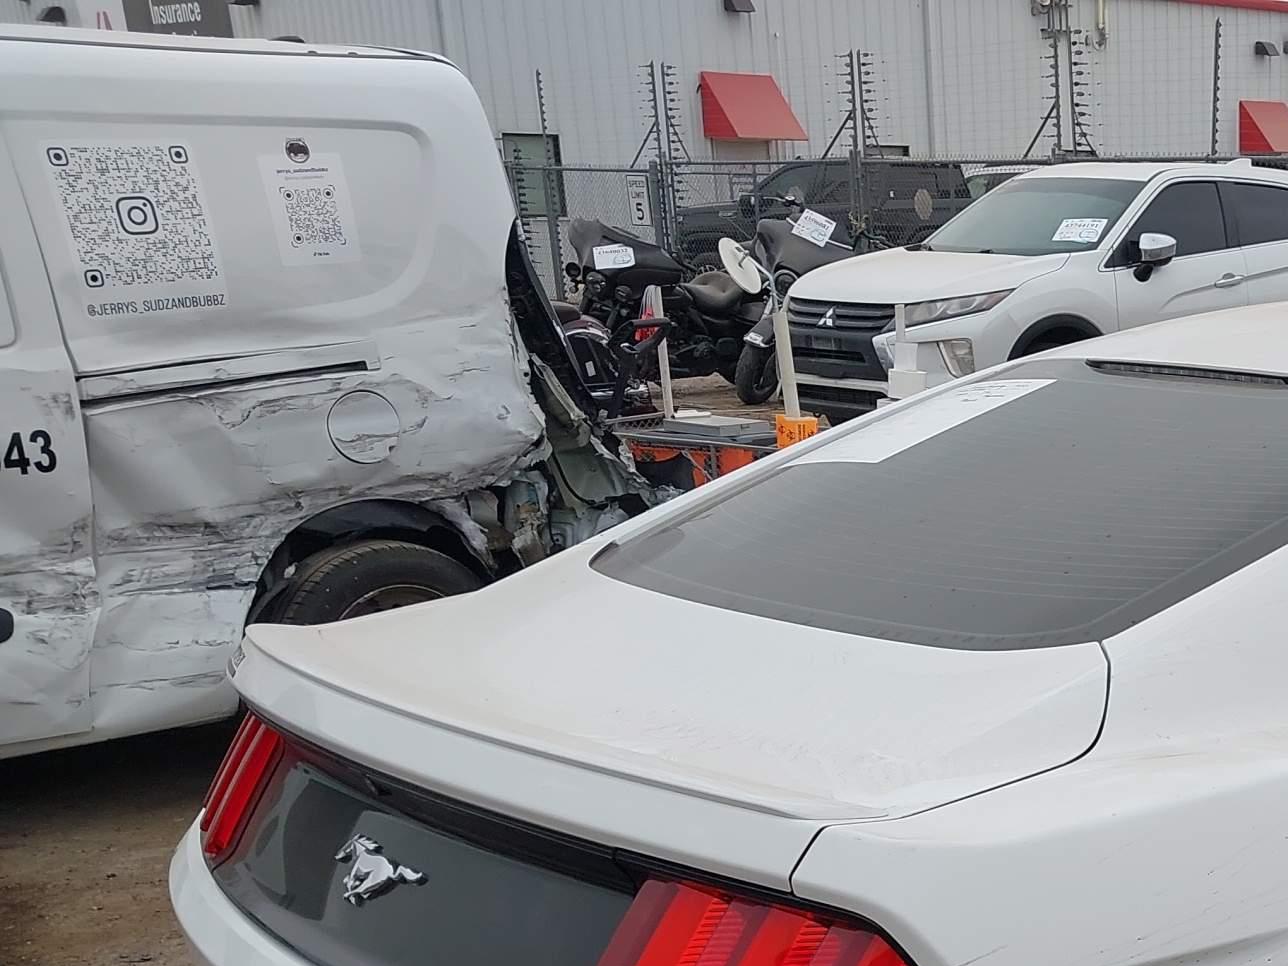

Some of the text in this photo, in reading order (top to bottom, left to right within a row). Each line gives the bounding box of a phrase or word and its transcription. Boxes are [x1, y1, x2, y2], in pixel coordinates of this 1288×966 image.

[149, 0, 201, 24] Insurance
[635, 202, 645, 221] 5
[87, 294, 226, 316] @JERRYS_SUDZANDBUBBZ
[0, 430, 57, 475] 43
